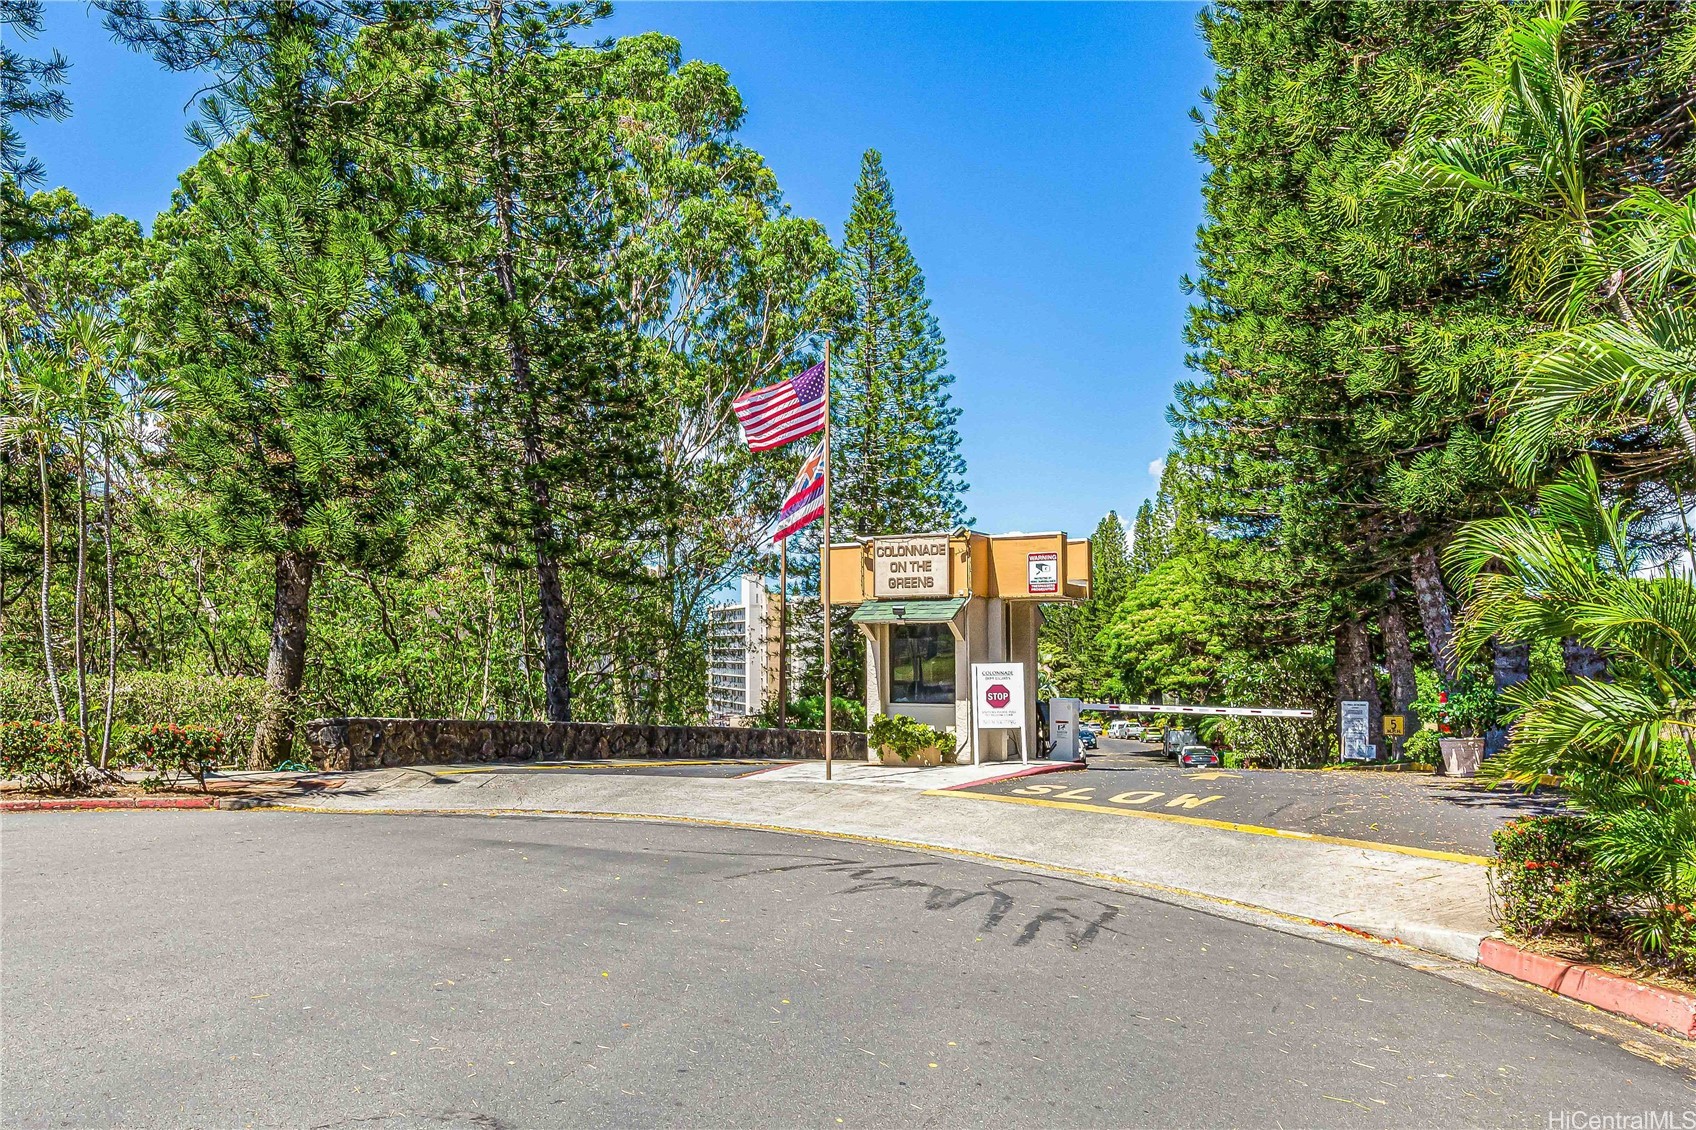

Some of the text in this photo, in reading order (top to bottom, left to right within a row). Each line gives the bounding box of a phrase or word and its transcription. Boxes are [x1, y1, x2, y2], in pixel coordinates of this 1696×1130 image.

[877, 544, 946, 557] COLONNADE
[890, 561, 932, 573] ON THE
[888, 577, 934, 589] GREENS
[987, 692, 1009, 701] STOP
[1390, 719, 1397, 730] 5
[1011, 784, 1226, 809] SLOW
